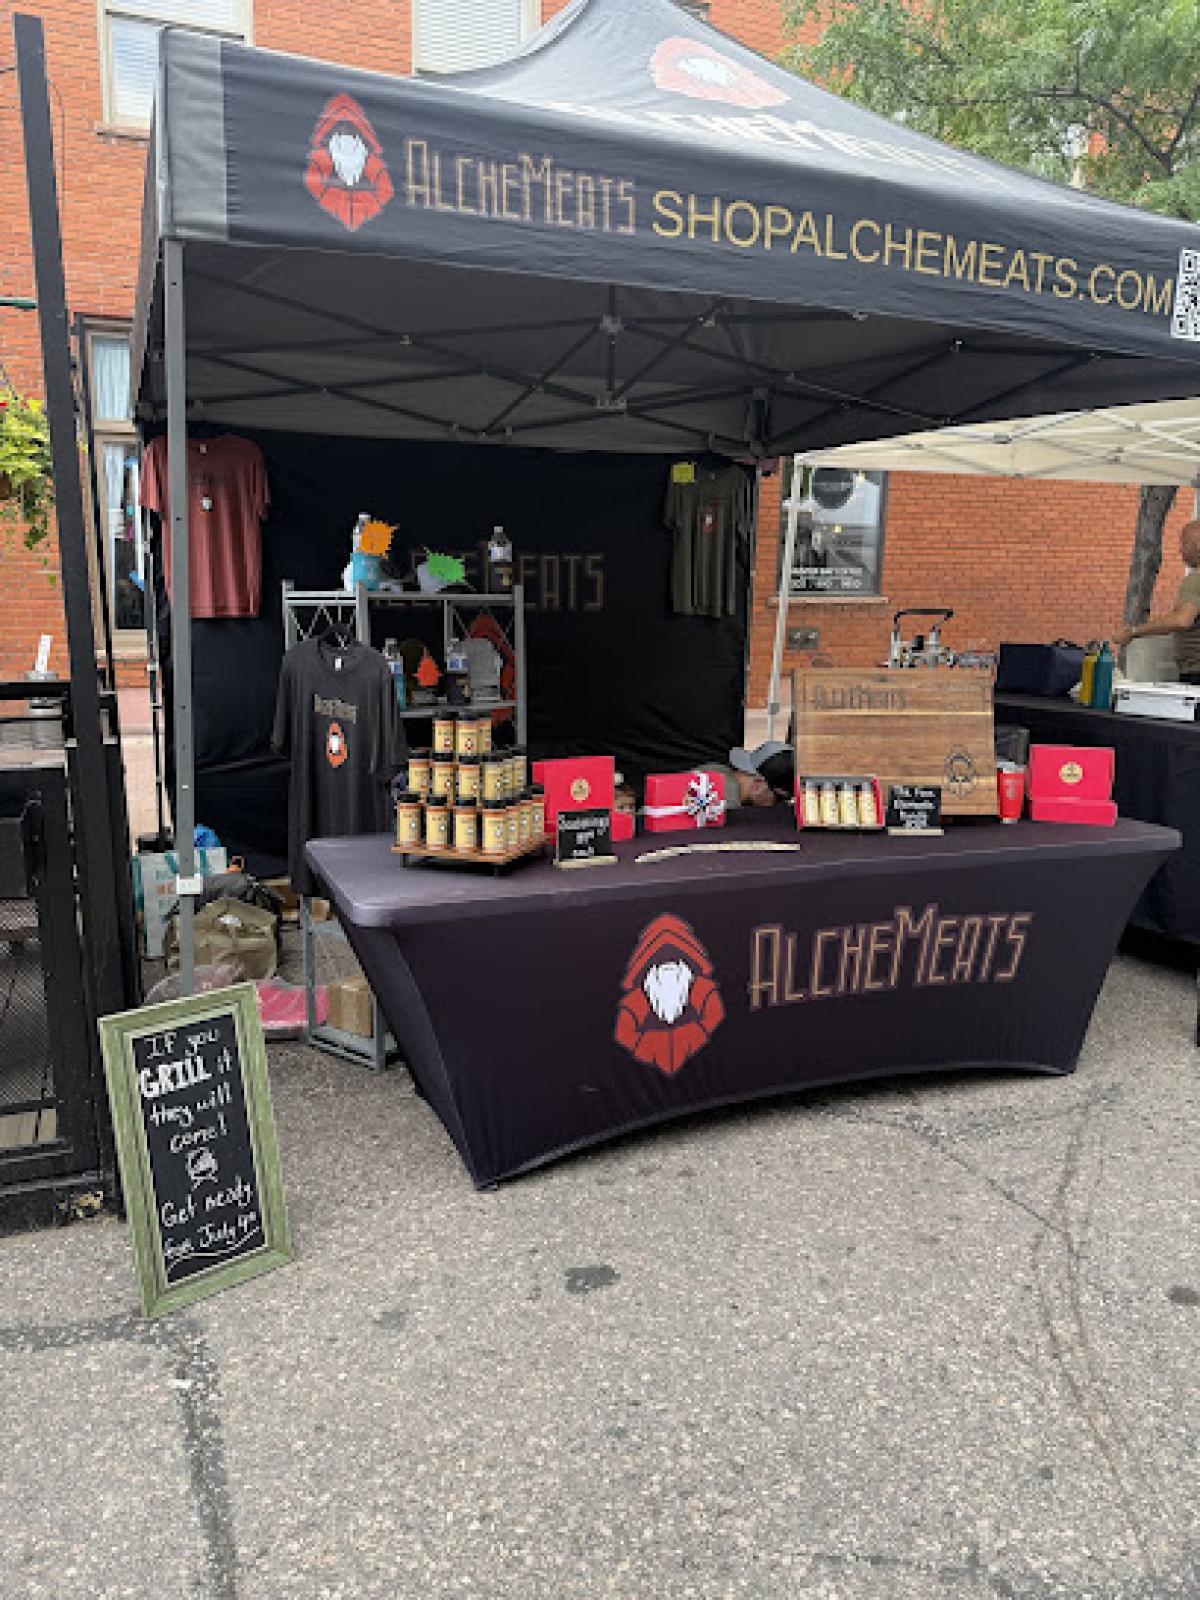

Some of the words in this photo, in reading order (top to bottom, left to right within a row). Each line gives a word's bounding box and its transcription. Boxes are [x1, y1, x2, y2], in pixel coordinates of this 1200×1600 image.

[651, 189, 1174, 316] SHOPALCHEMEATS.COM
[138, 1055, 213, 1098] GRILL
[161, 1194, 197, 1228] Get
[205, 1174, 252, 1212] ready
